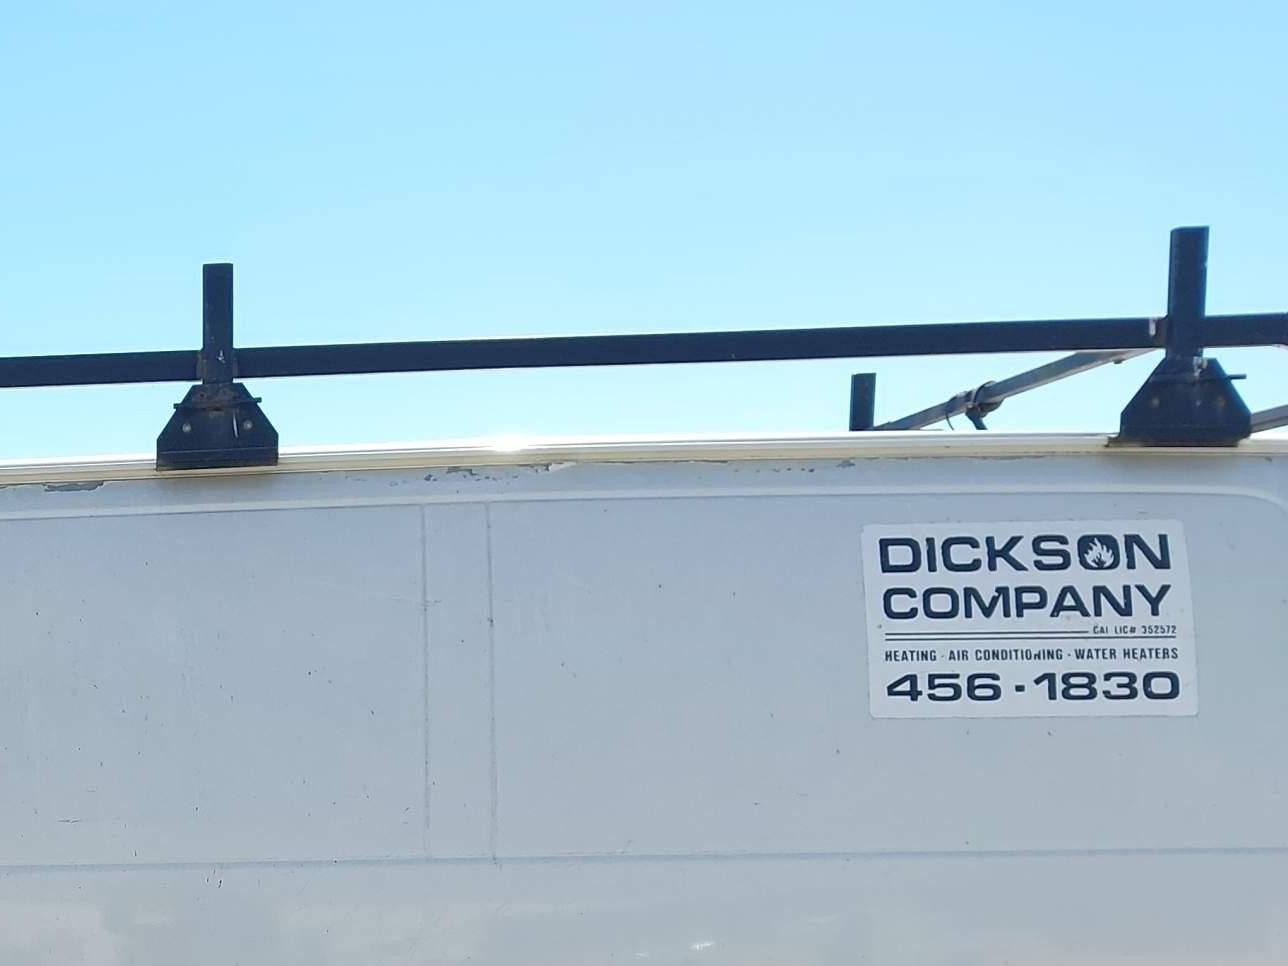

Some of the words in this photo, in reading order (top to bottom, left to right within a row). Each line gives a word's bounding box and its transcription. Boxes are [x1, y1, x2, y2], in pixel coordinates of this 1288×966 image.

[878, 533, 1171, 573] DICKSON
[882, 584, 1172, 620] COMPANY
[1141, 624, 1177, 635] 352572
[884, 649, 937, 662] HEATING
[948, 649, 969, 662] AIR
[974, 648, 1063, 662] CONDITIONING
[1075, 648, 1117, 660] WATER
[1123, 647, 1179, 661] HEATERS
